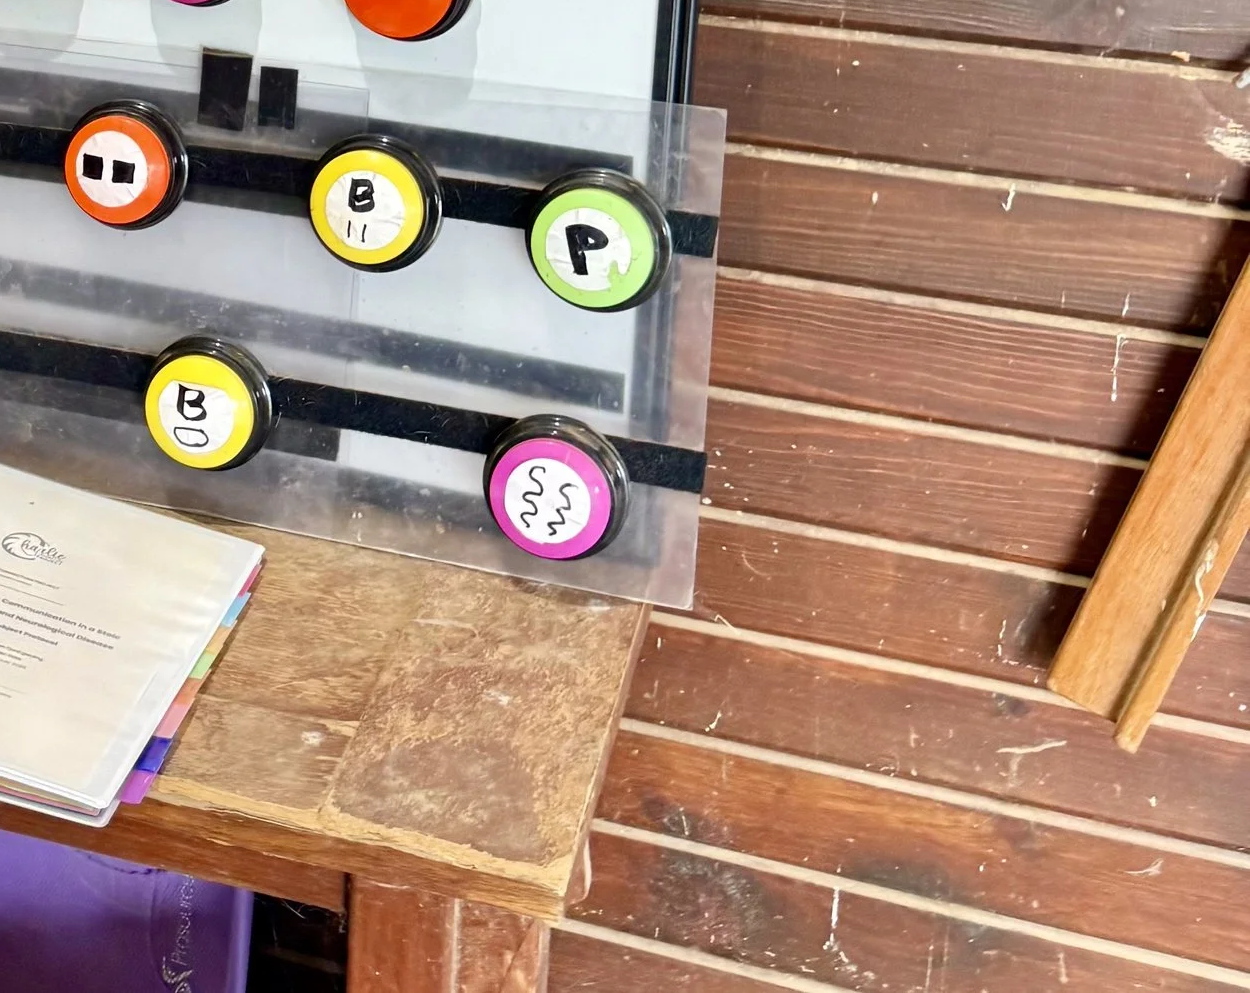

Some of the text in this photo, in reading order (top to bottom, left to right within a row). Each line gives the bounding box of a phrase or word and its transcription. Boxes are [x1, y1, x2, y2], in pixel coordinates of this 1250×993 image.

[348, 177, 375, 213] B
[565, 223, 609, 275] P
[176, 383, 207, 421] B
[1, 598, 77, 626] Communication
[78, 622, 87, 630] in
[15, 615, 75, 638] Neurological
[76, 634, 114, 650] Disease
